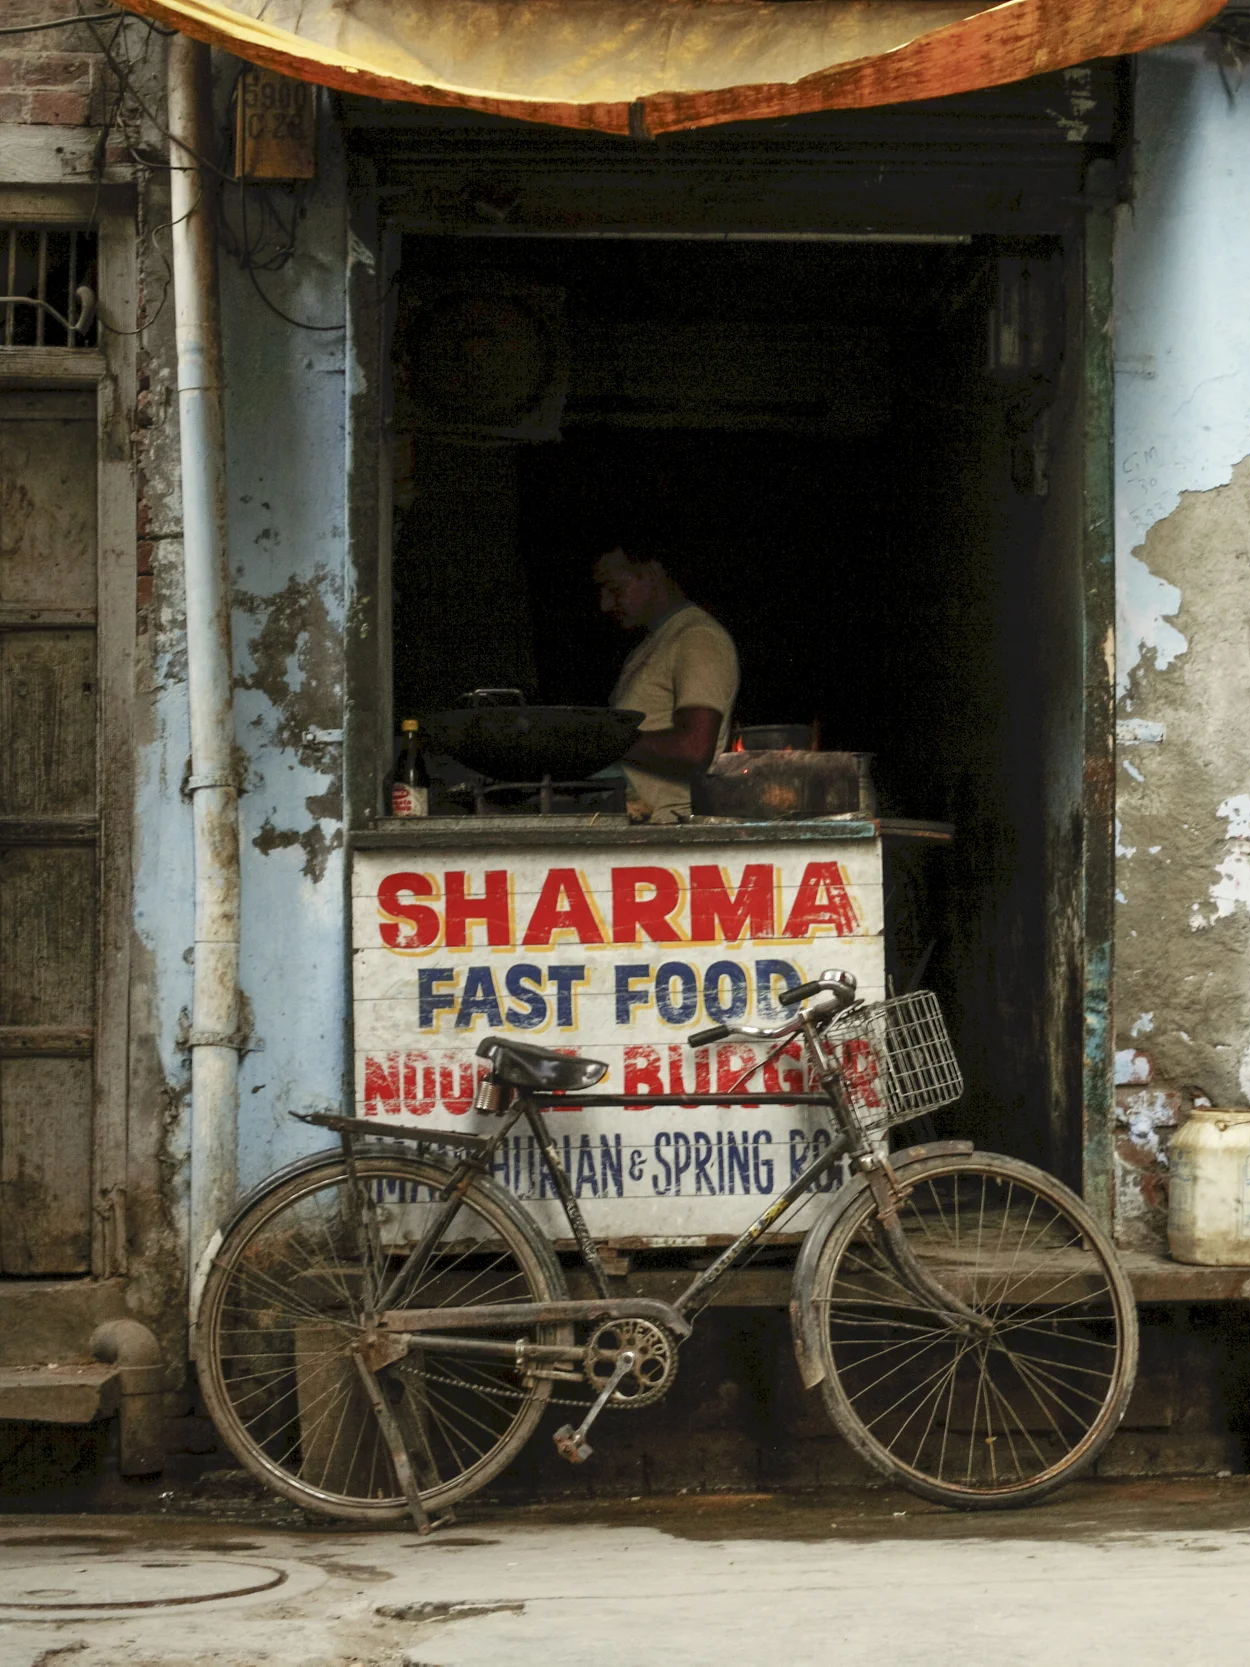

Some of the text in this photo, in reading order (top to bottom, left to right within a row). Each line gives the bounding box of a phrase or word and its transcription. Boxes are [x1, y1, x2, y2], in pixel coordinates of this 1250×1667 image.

[377, 860, 866, 955] SHARMA
[417, 959, 806, 1030] FAST FOOD
[629, 1150, 647, 1182] &
[652, 1129, 775, 1196] SPRING
